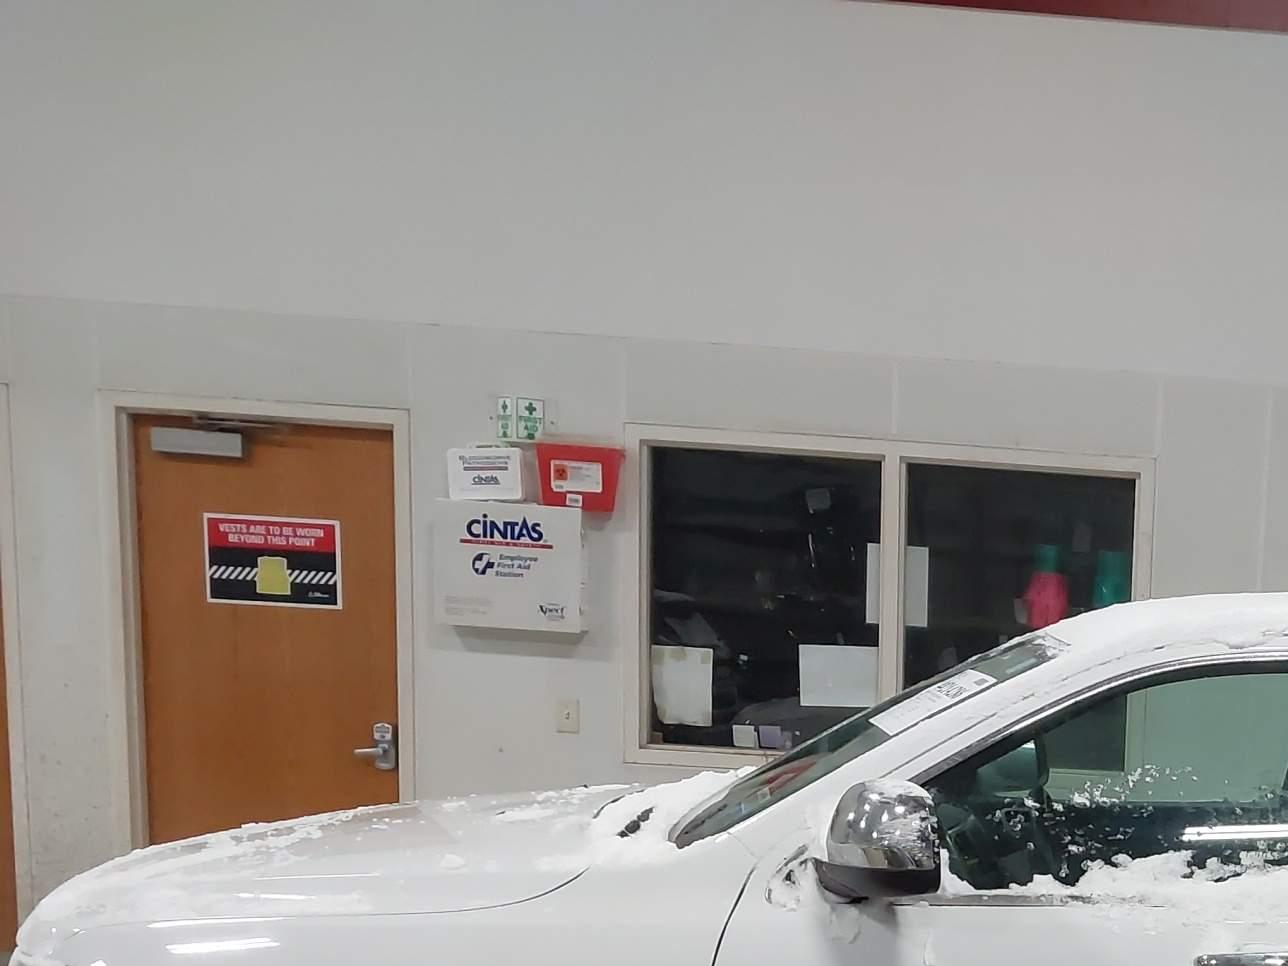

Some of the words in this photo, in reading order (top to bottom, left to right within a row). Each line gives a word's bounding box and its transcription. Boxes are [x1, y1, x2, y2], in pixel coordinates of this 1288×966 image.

[218, 523, 247, 533] VESTS
[249, 525, 266, 534] ARE
[268, 526, 281, 535] TO
[282, 527, 294, 536] BE
[296, 527, 324, 537] WORN
[228, 534, 265, 544] BEYOND
[267, 536, 287, 545] THIS
[289, 537, 315, 546] POINT
